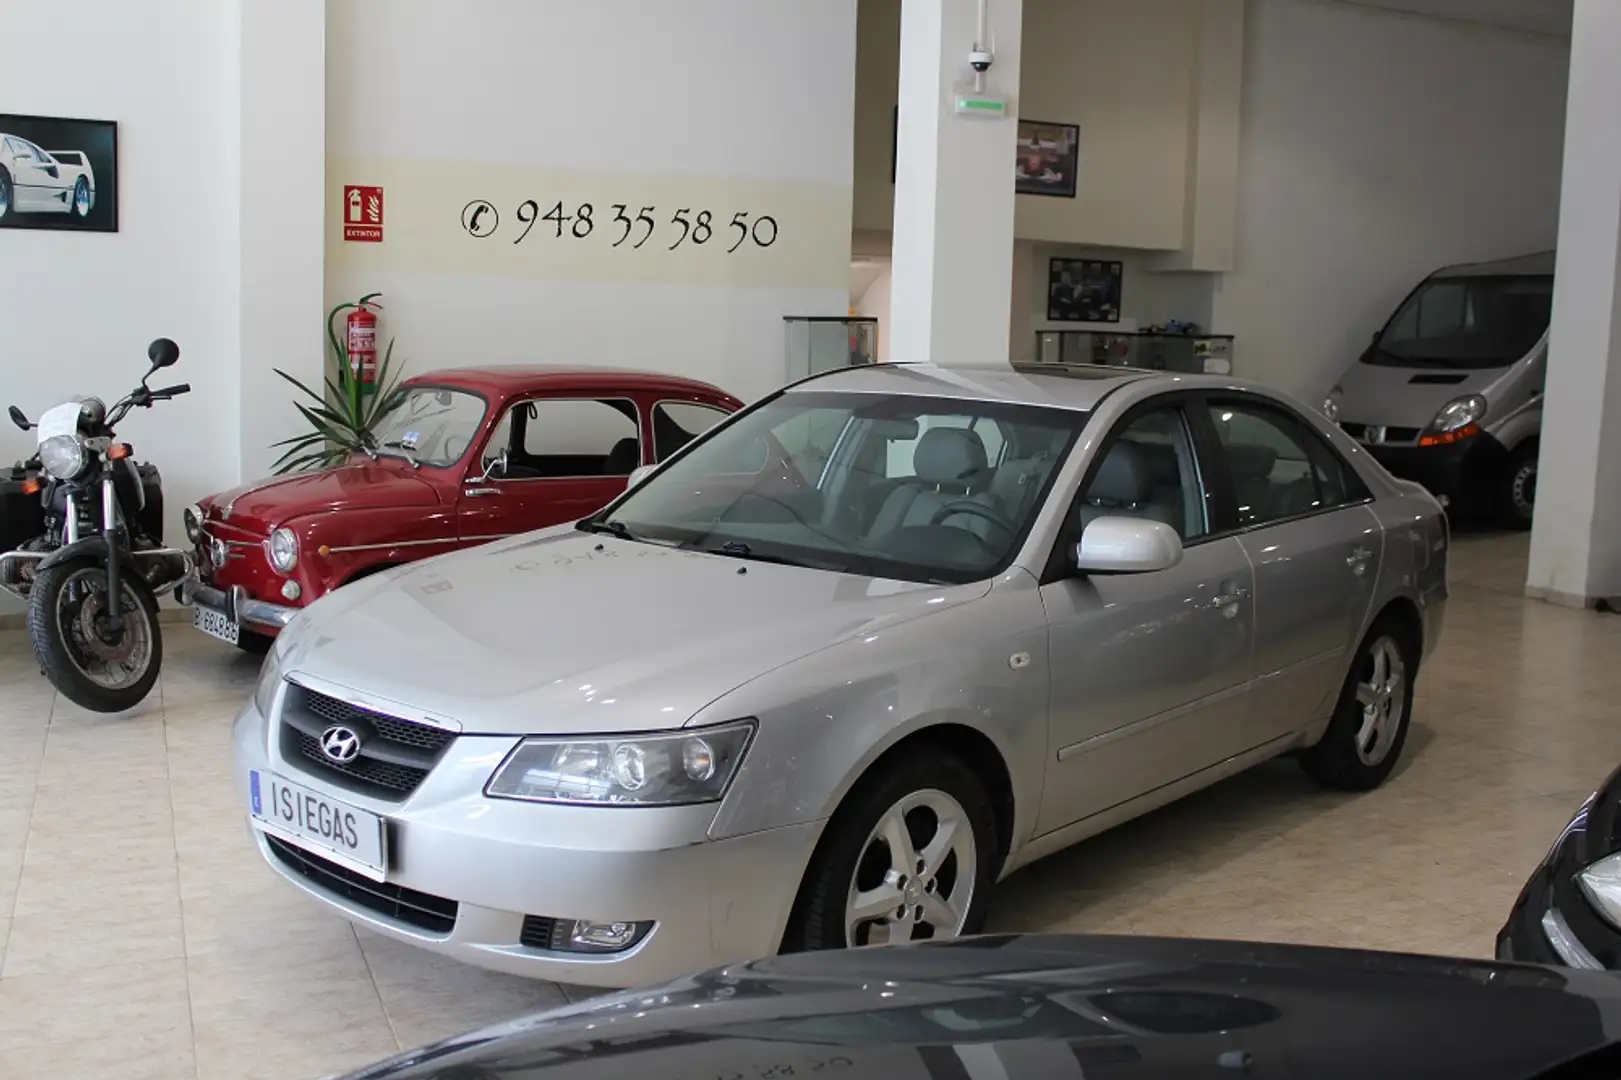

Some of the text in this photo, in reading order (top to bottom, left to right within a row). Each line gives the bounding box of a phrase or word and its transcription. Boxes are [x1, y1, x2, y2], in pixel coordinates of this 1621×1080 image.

[346, 229, 381, 238] EXTINTOR
[513, 199, 778, 254] 948 35 58 50
[271, 781, 358, 850] ISIEGAS
